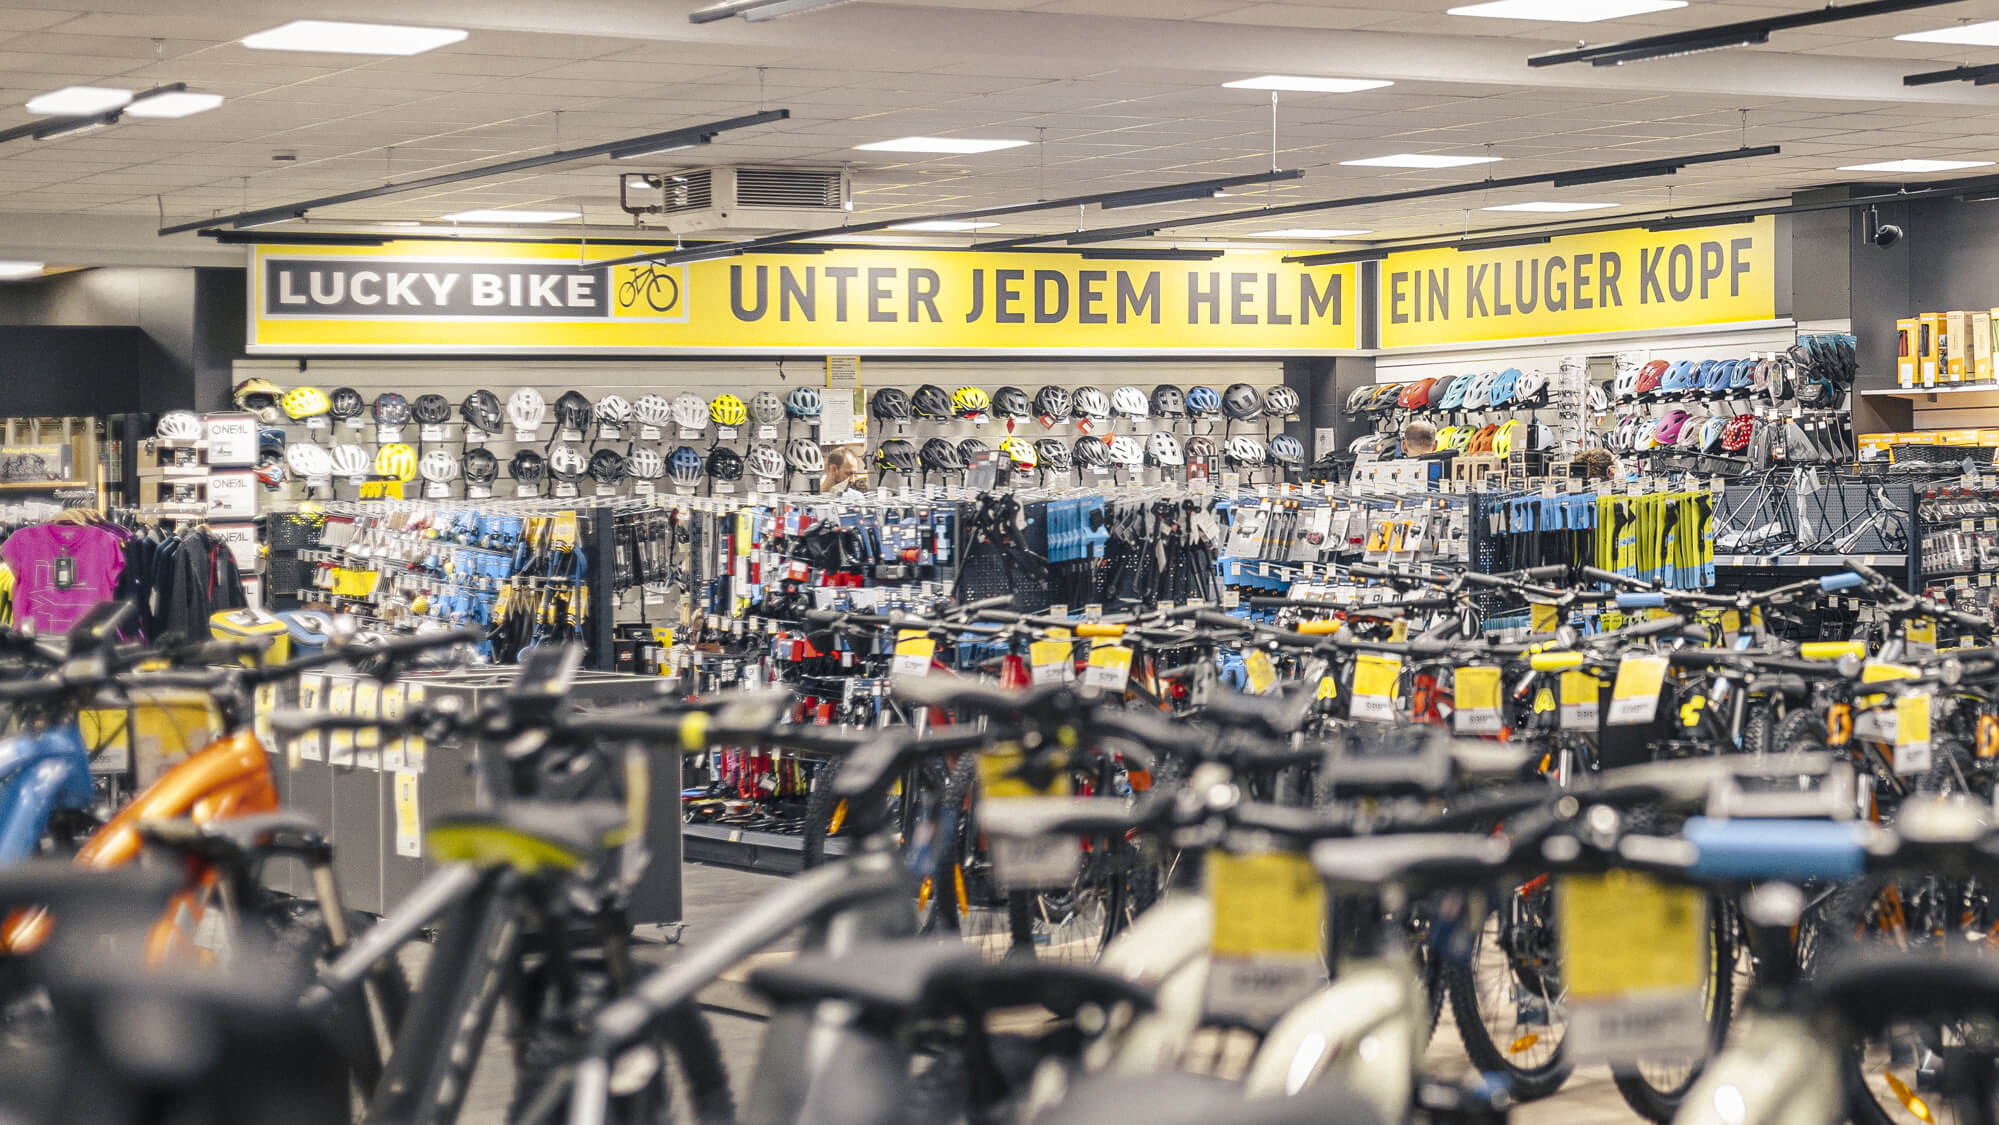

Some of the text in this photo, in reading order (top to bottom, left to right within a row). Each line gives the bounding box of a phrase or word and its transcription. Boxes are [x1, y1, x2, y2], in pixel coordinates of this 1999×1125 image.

[279, 271, 596, 307] LUCKY BIKE
[729, 264, 1342, 326] UNTER JEDEM HELM
[1390, 237, 1754, 324] EIN KLUGER KOPF
